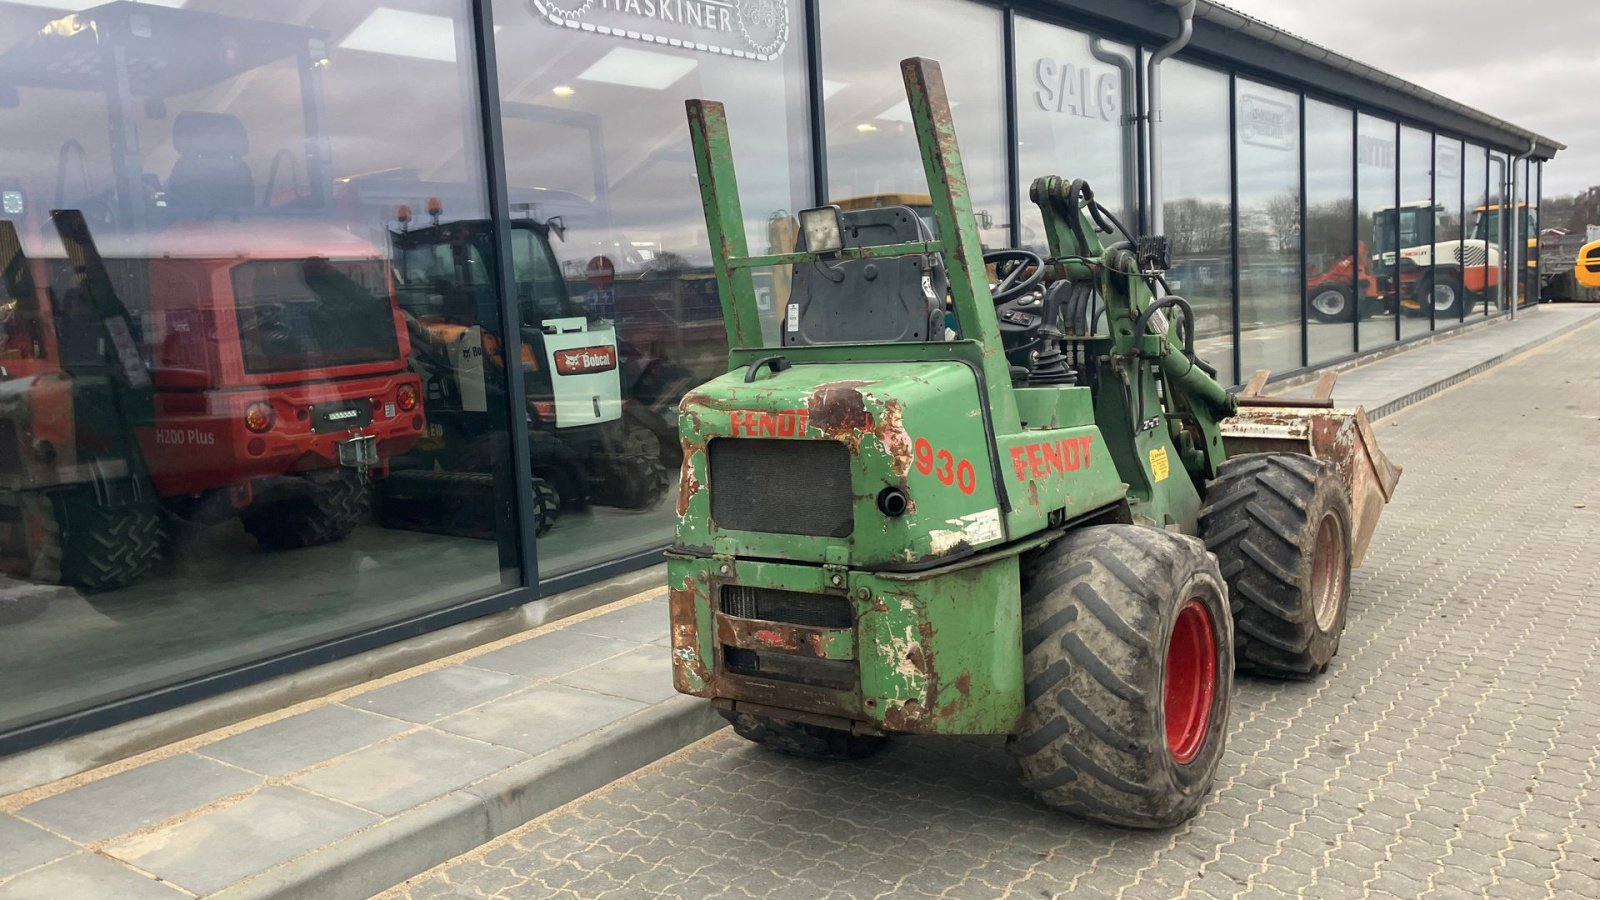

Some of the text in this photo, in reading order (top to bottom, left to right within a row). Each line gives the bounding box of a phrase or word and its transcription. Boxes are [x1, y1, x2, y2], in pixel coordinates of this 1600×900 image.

[1036, 57, 1121, 121] SALG
[583, 353, 611, 368] Bobcat
[156, 429, 215, 445] H200 Plus
[730, 409, 809, 437] FENDT
[914, 436, 977, 496] 930
[1009, 435, 1094, 482] FENDT
